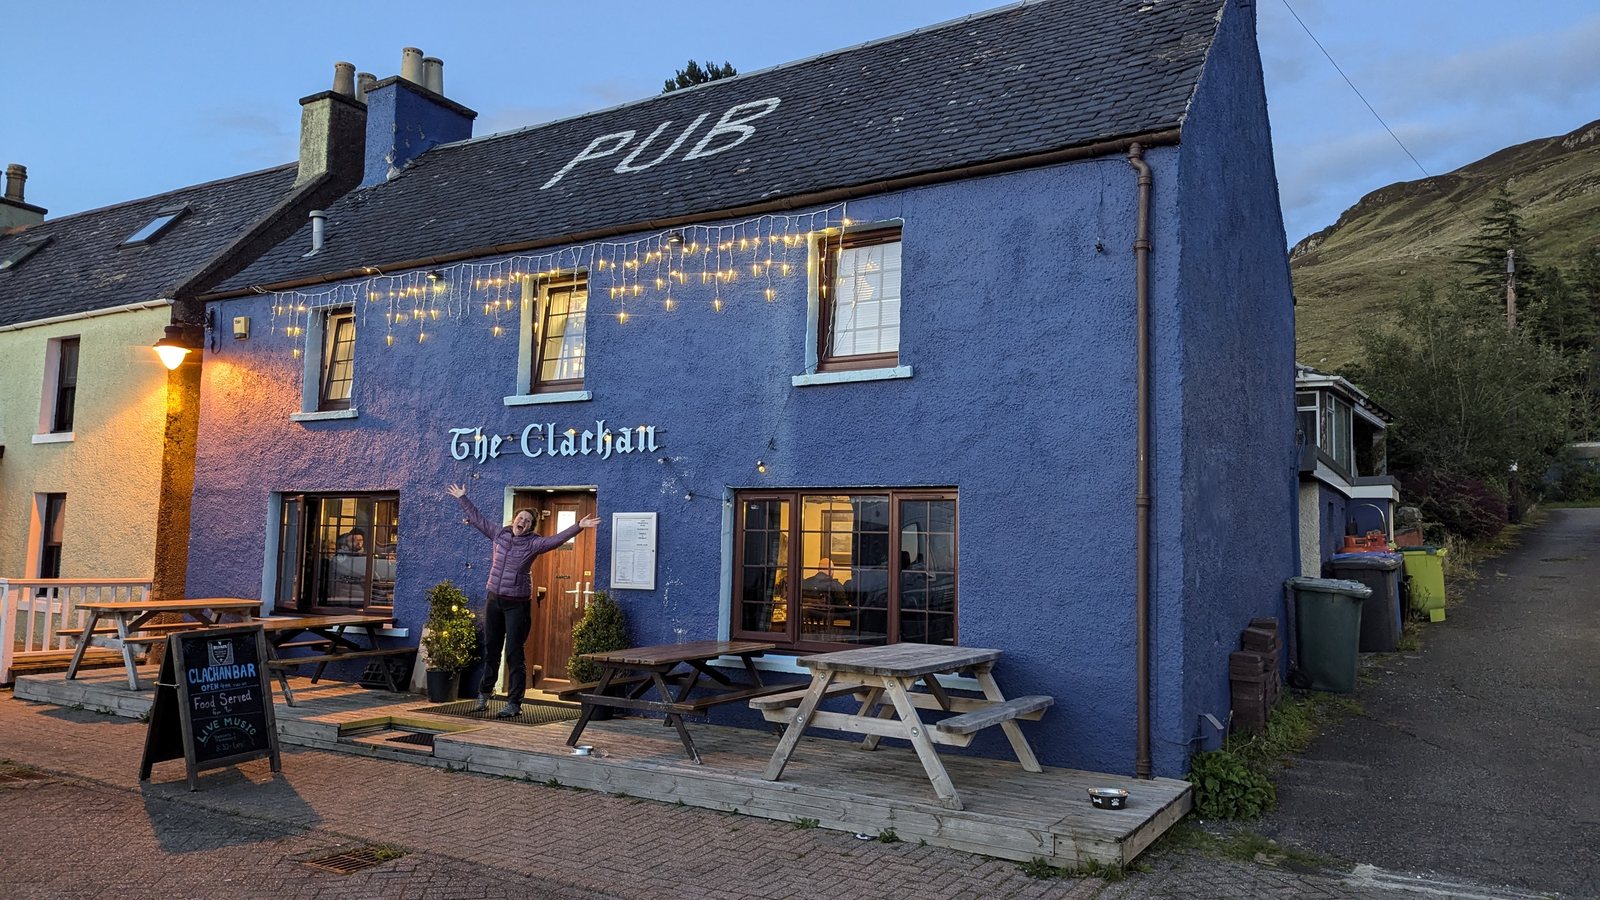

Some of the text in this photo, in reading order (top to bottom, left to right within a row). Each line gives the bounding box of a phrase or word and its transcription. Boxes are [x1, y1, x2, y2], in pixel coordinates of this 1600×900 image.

[539, 97, 782, 190] PUB
[448, 419, 659, 464] The Clachan
[194, 689, 252, 710] Food Served
[201, 683, 219, 692] OPEN
[196, 720, 220, 743] LIVE
[223, 717, 257, 735] MUSIC
